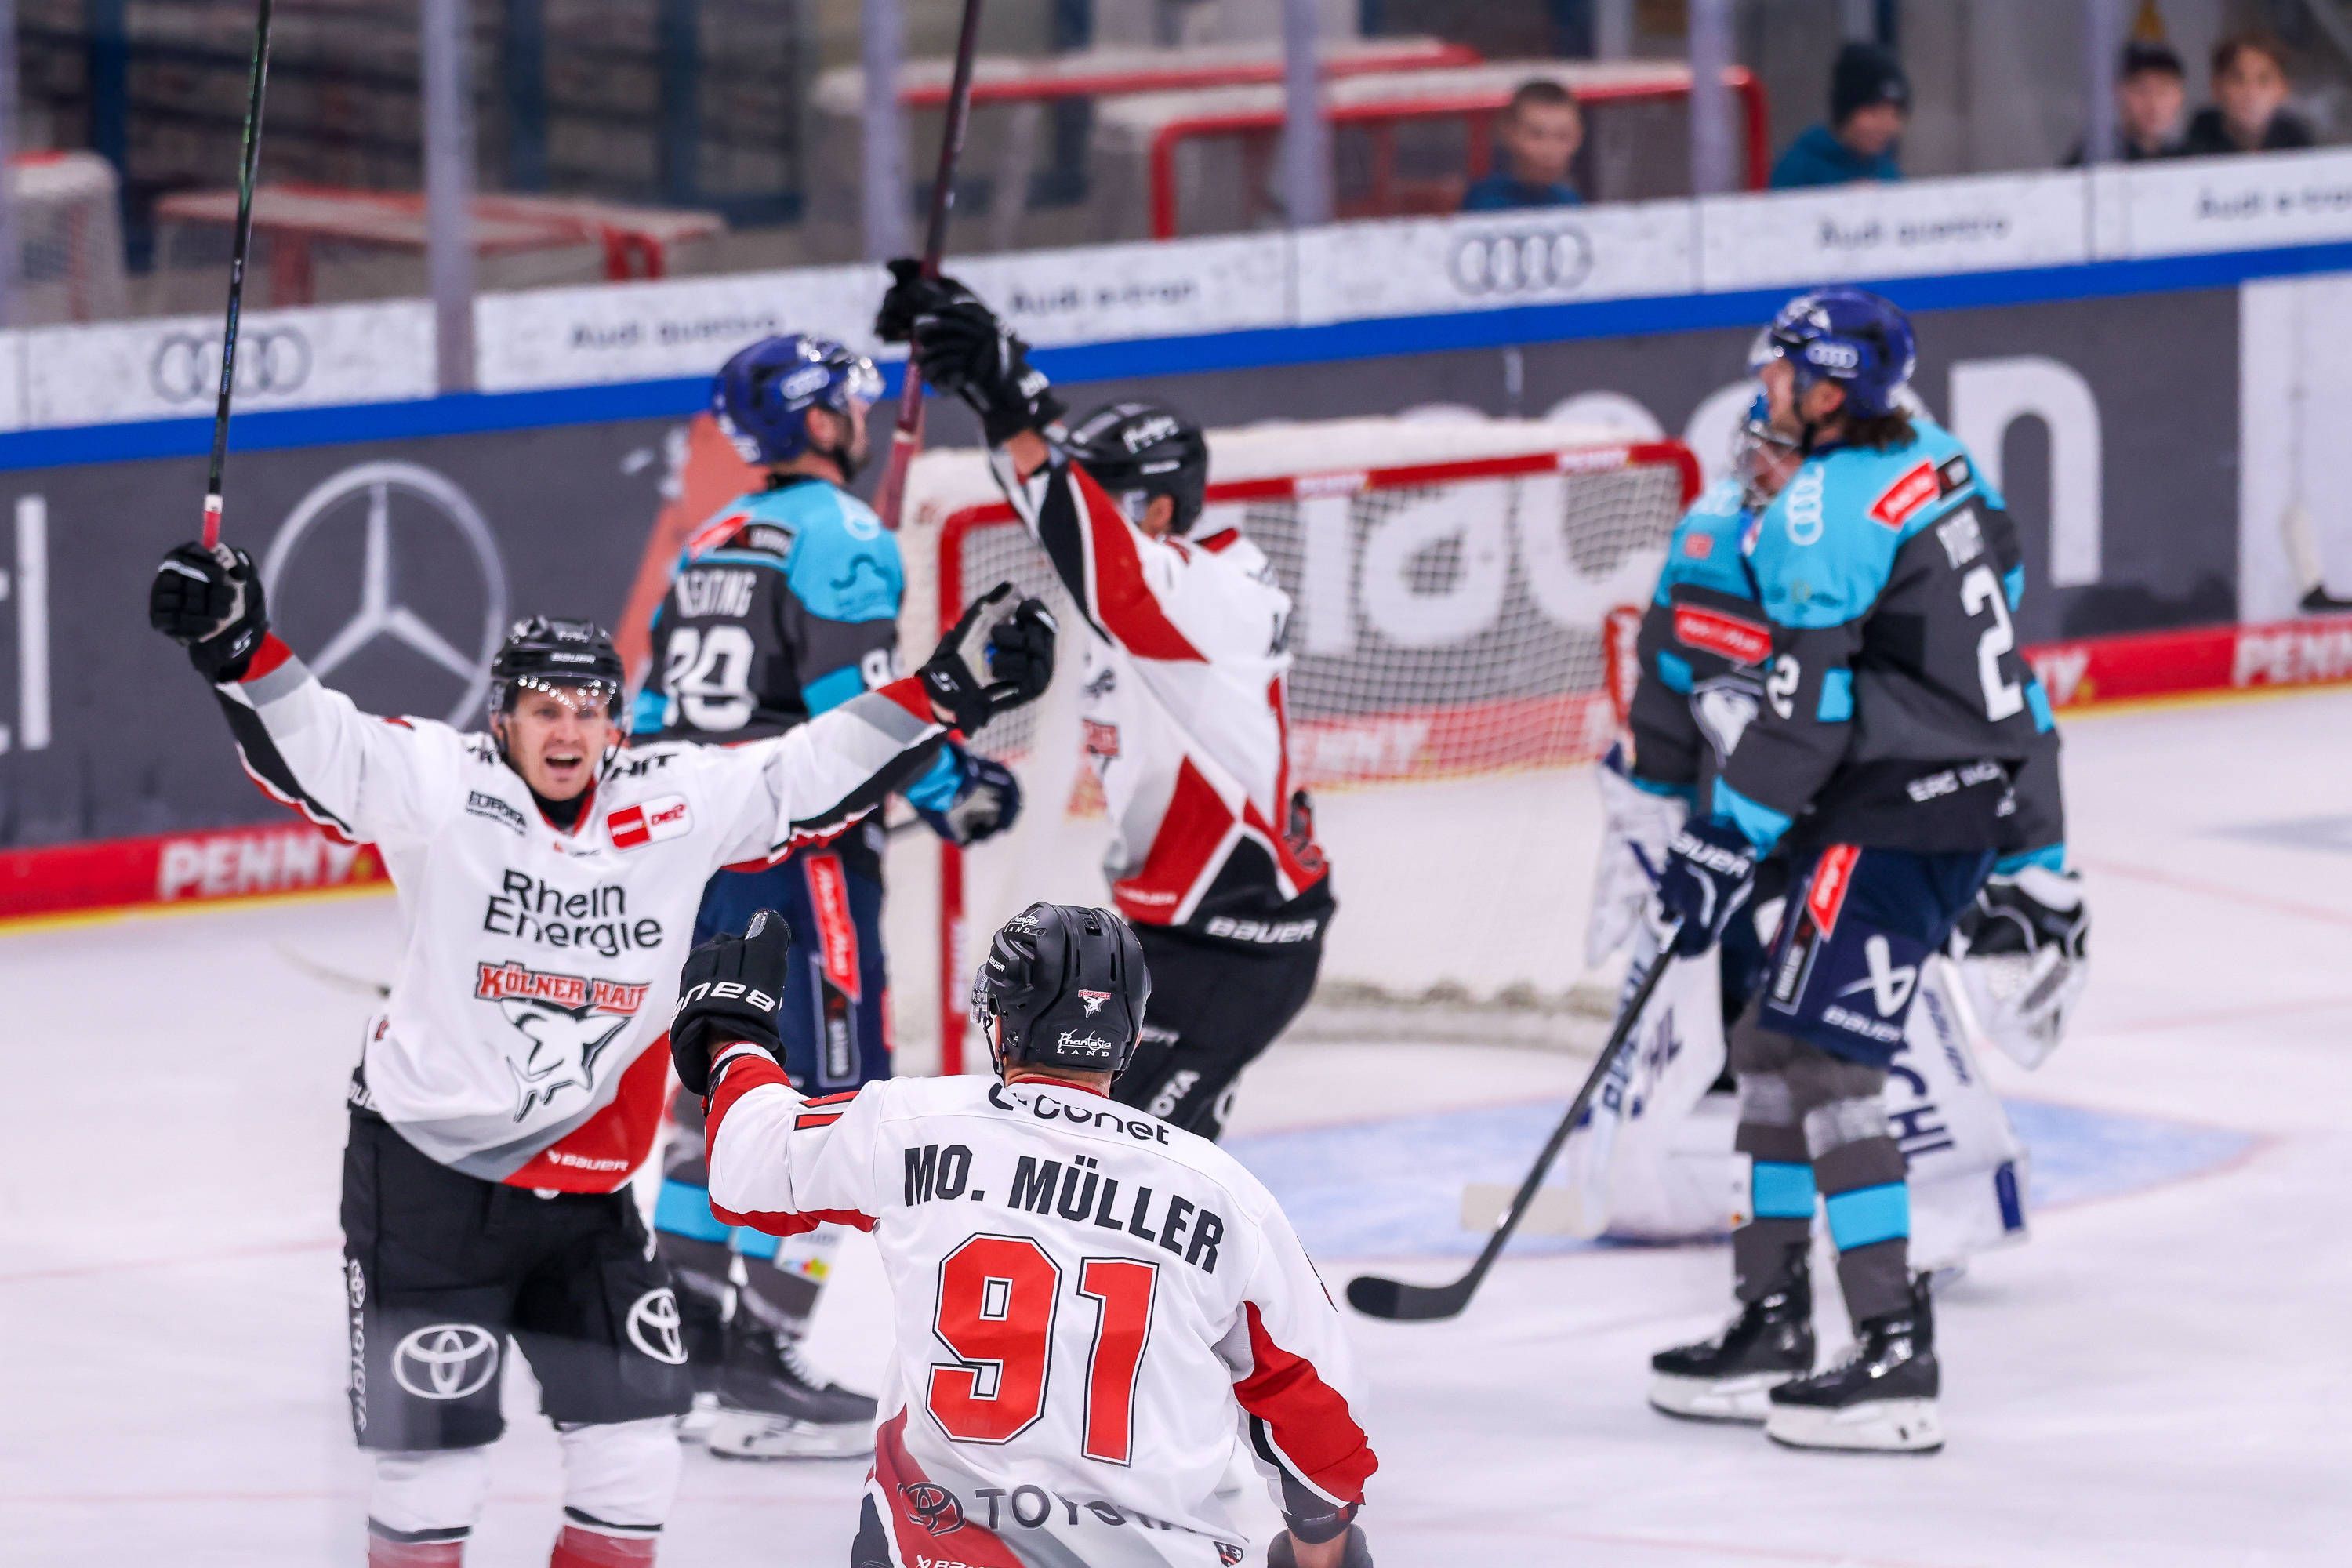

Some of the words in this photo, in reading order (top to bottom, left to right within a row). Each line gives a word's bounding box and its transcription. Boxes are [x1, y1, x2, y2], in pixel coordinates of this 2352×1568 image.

[1961, 564, 2024, 722] 2
[159, 832, 359, 901] PENNY
[503, 868, 628, 918] Rhein
[483, 895, 663, 957] Energie
[1206, 915, 1319, 945] BAUER
[477, 961, 586, 1004] KÖLNER
[1056, 1047, 1110, 1057] LAND
[1058, 1029, 1112, 1051] Phantasia
[560, 1152, 629, 1171] BAUER
[904, 1144, 985, 1207] MO.
[1007, 1154, 1225, 1275] MÜLLER
[926, 1232, 1160, 1468] 91
